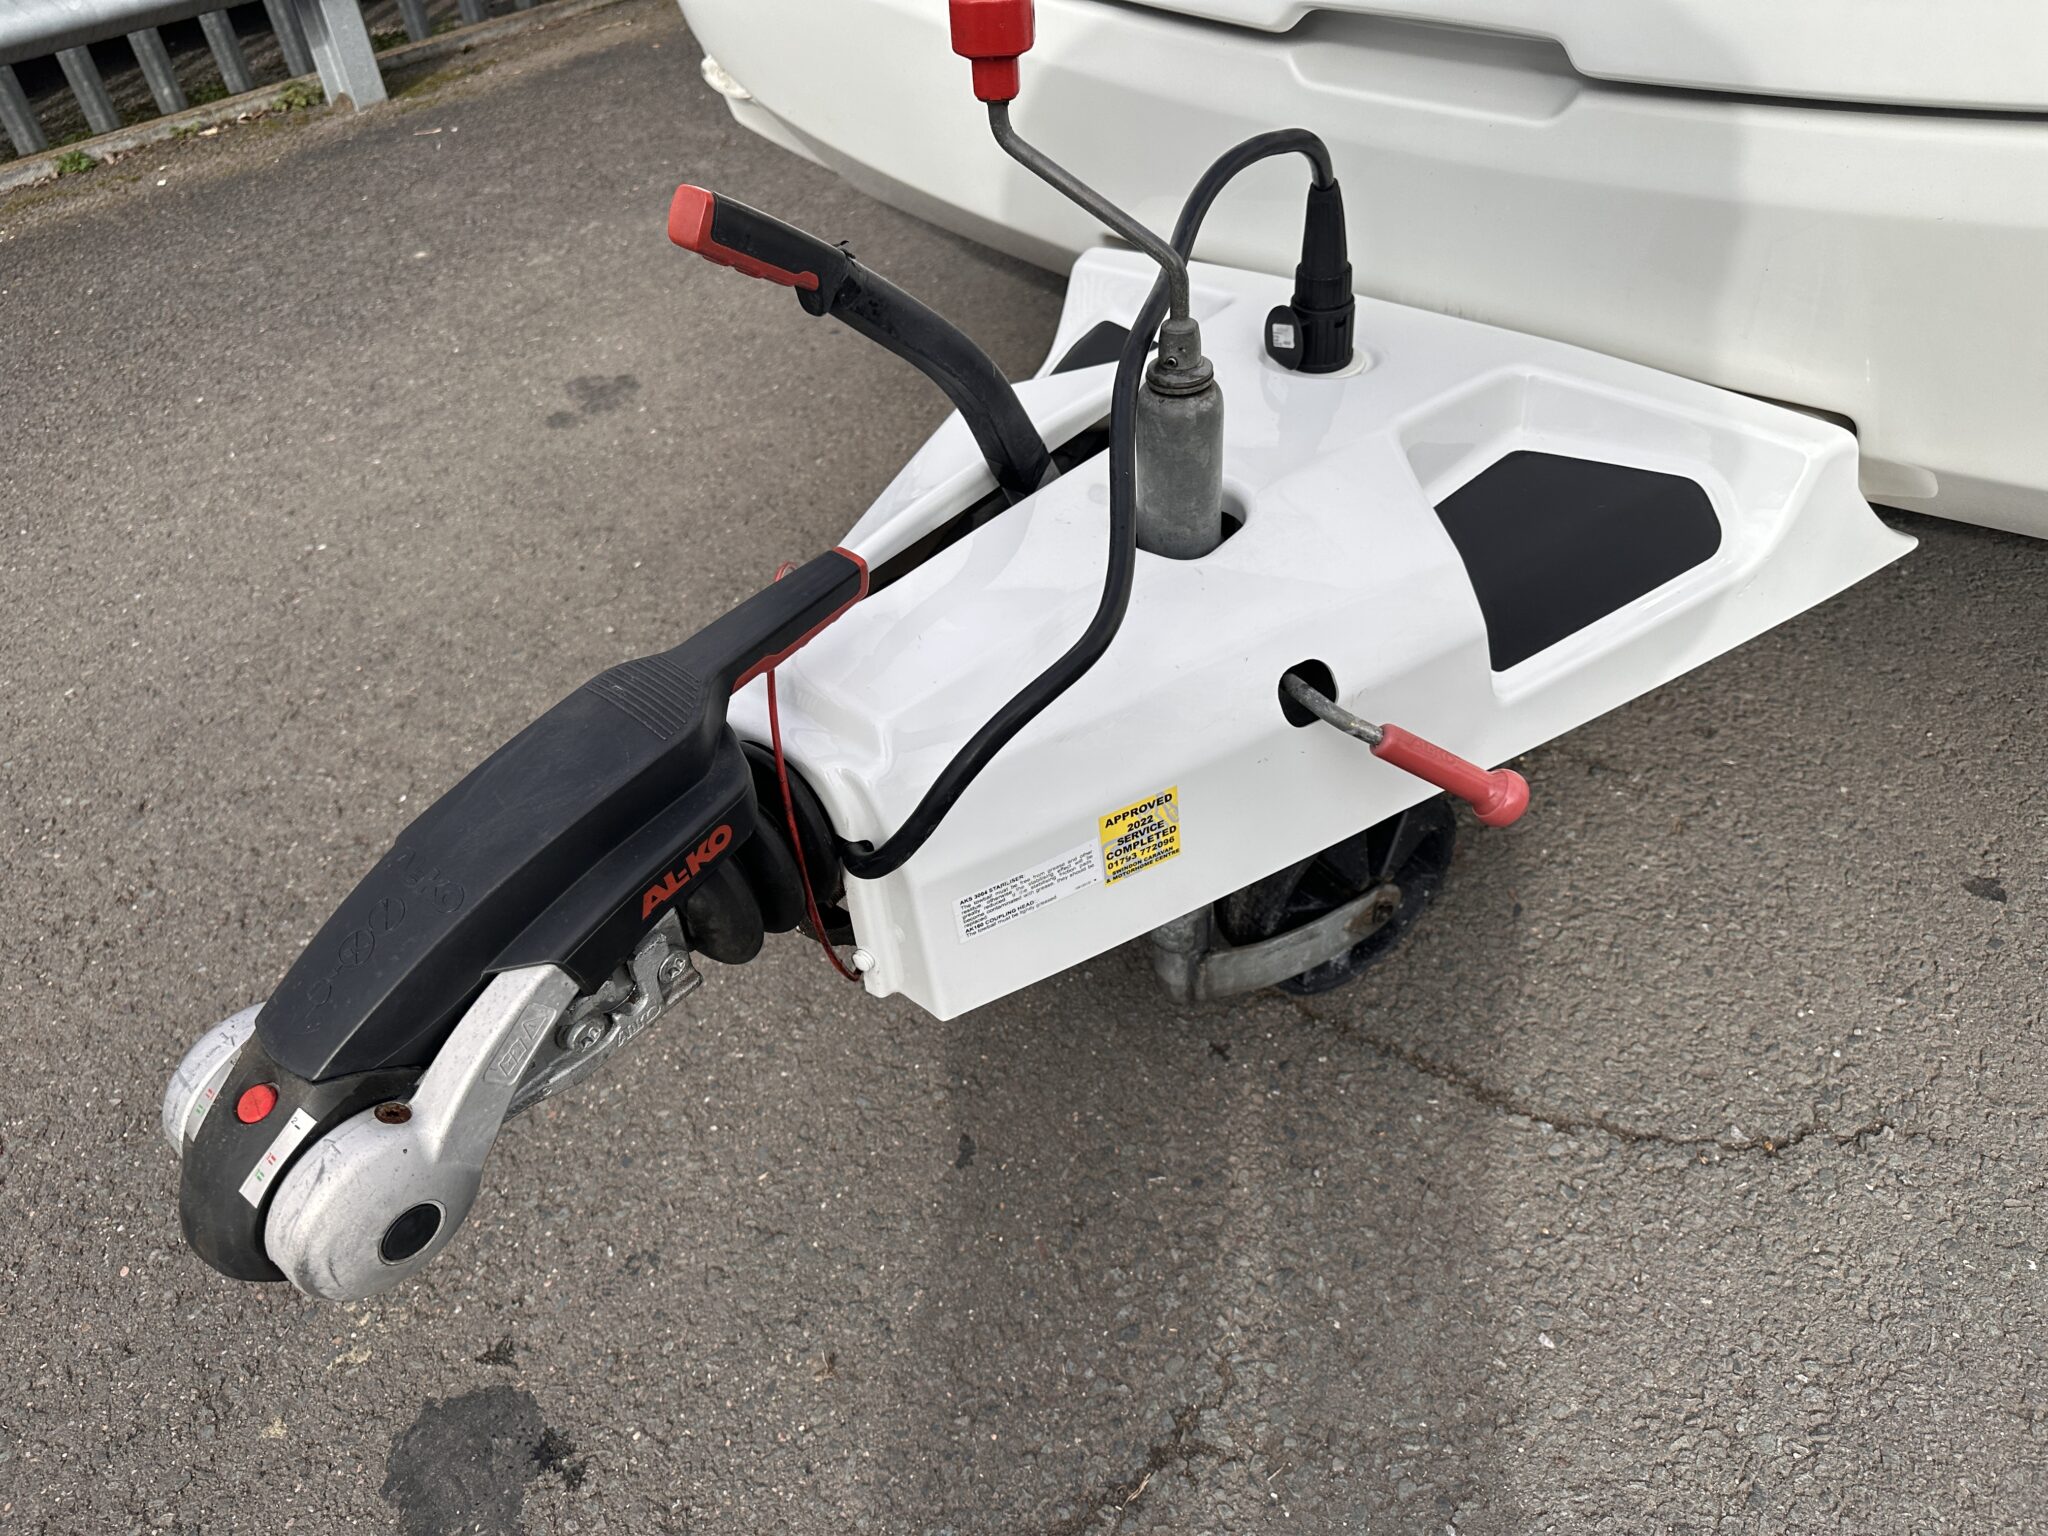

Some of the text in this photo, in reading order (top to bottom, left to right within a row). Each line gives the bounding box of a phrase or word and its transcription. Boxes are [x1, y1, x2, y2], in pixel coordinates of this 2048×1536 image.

[1105, 793, 1172, 828] APPROVED
[1127, 815, 1153, 832] 2022
[1106, 825, 1176, 860] COMPLETED
[1117, 820, 1164, 846] SERVICE
[1140, 836, 1175, 855] 772096
[642, 824, 733, 921] AL-KO
[1112, 846, 1173, 875] SWINDON CARAVAN
[1112, 860, 1154, 880] MOTORHOME
[1155, 847, 1180, 862] CENTRE
